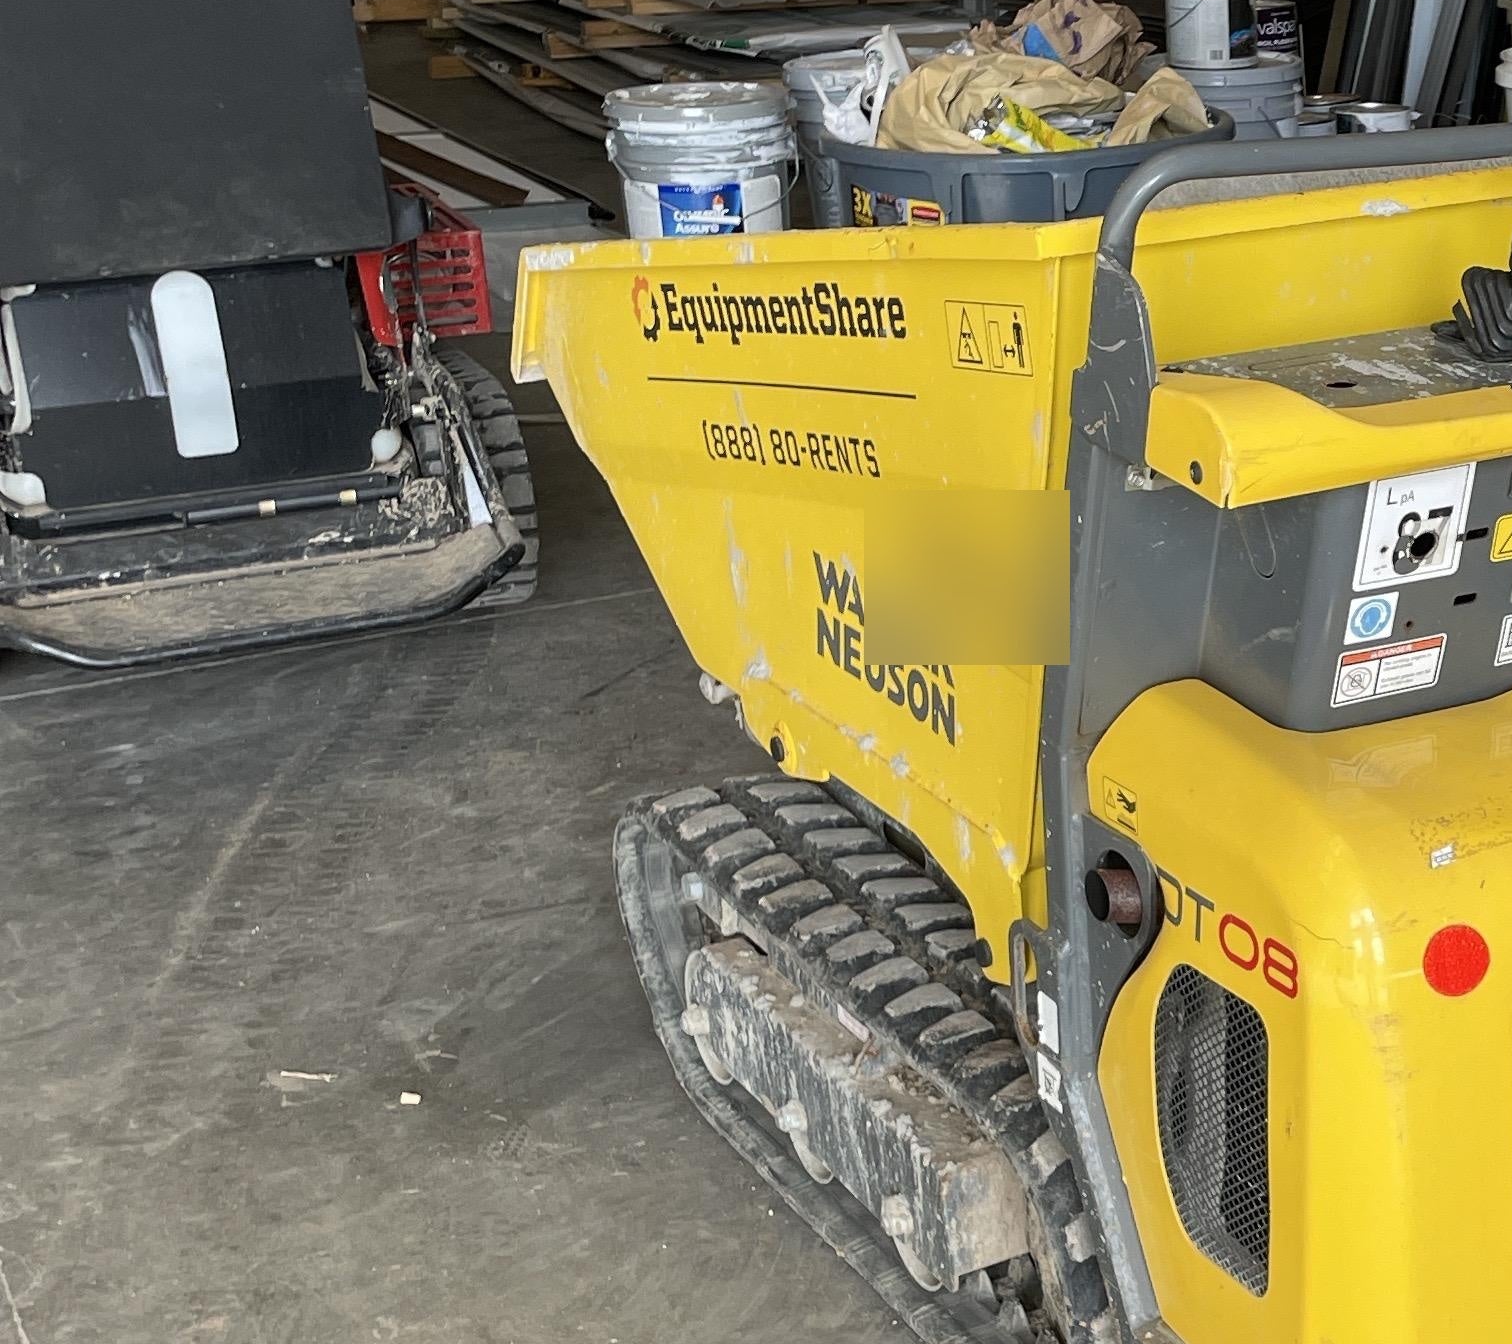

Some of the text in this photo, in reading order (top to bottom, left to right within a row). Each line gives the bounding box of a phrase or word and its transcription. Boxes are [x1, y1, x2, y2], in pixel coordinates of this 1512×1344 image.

[660, 282, 907, 345] EquipmentShare
[702, 419, 881, 478] (888) 80-RENTS
